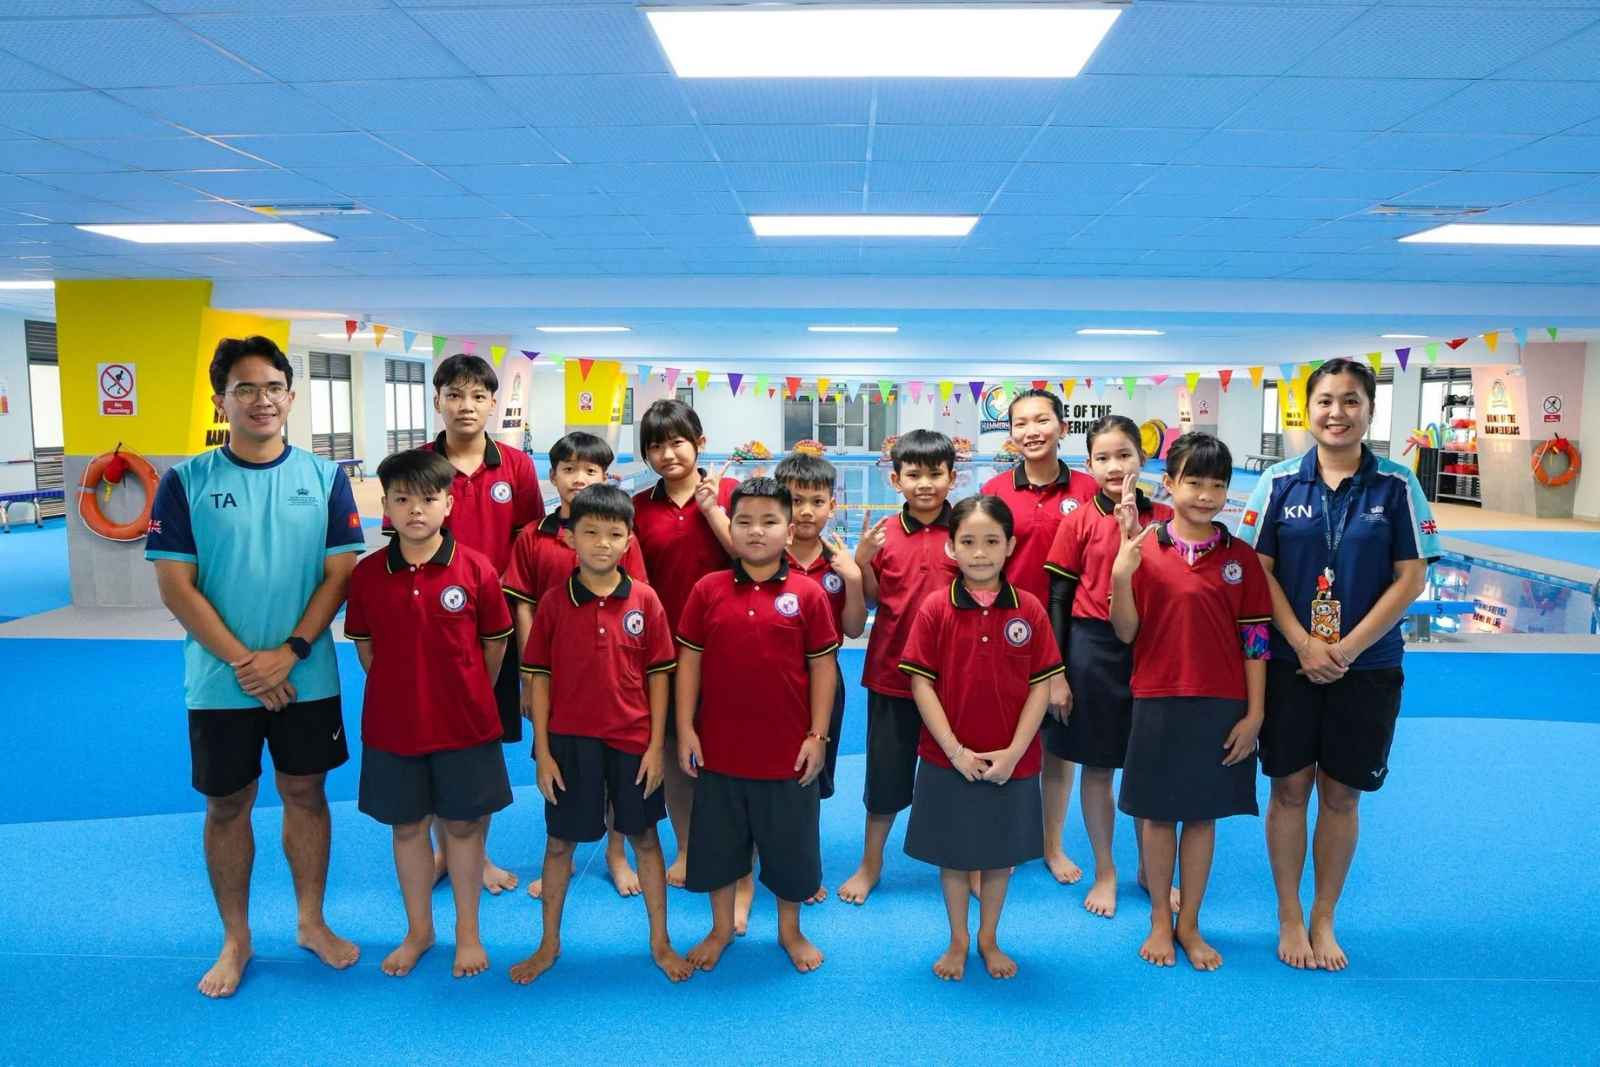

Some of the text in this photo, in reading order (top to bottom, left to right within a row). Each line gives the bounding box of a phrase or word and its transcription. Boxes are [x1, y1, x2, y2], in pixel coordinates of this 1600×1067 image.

[1073, 405, 1087, 418] OF
[1090, 405, 1112, 418] THE
[210, 493, 238, 508] TA
[1284, 505, 1312, 519] KN
